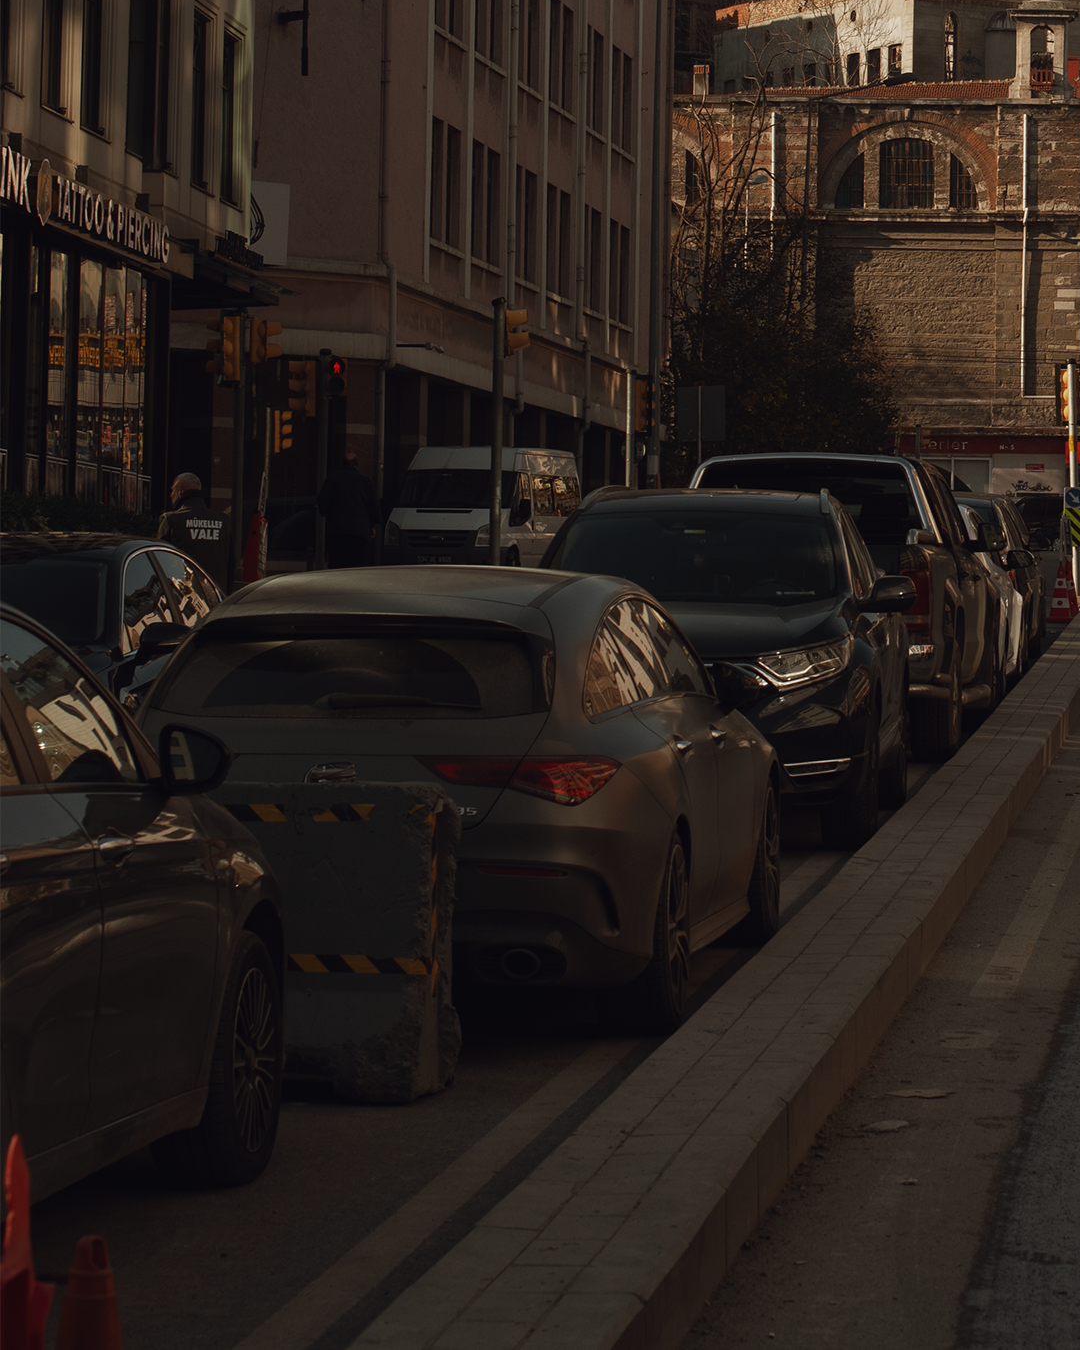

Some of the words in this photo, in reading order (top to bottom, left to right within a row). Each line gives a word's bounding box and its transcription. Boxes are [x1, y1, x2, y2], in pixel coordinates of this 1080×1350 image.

[57, 175, 105, 236] TATTOO
[106, 199, 115, 241] &
[117, 203, 171, 264] PIERCING
[185, 516, 223, 529] MÜKELLEF
[189, 528, 220, 540] VALE
